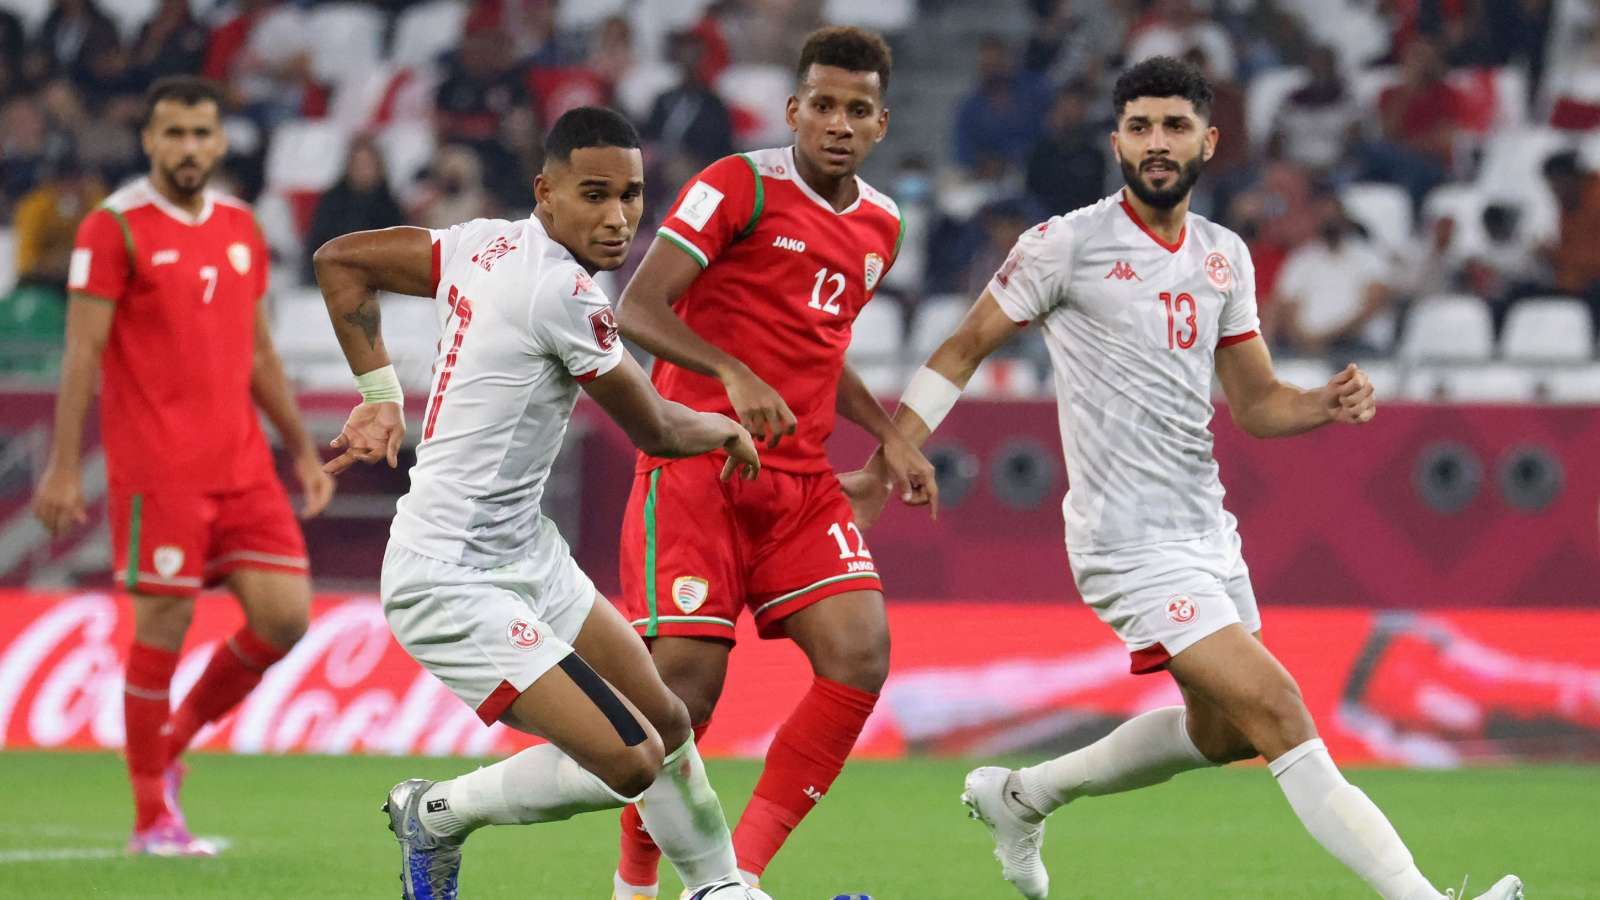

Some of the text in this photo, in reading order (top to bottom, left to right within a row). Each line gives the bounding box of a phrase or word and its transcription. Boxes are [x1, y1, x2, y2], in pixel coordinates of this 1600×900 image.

[772, 235, 806, 253] JAKO
[199, 265, 219, 305] 7
[807, 267, 847, 316] 12
[1159, 292, 1198, 350] 13
[826, 521, 873, 560] 12
[802, 785, 824, 801] JA
